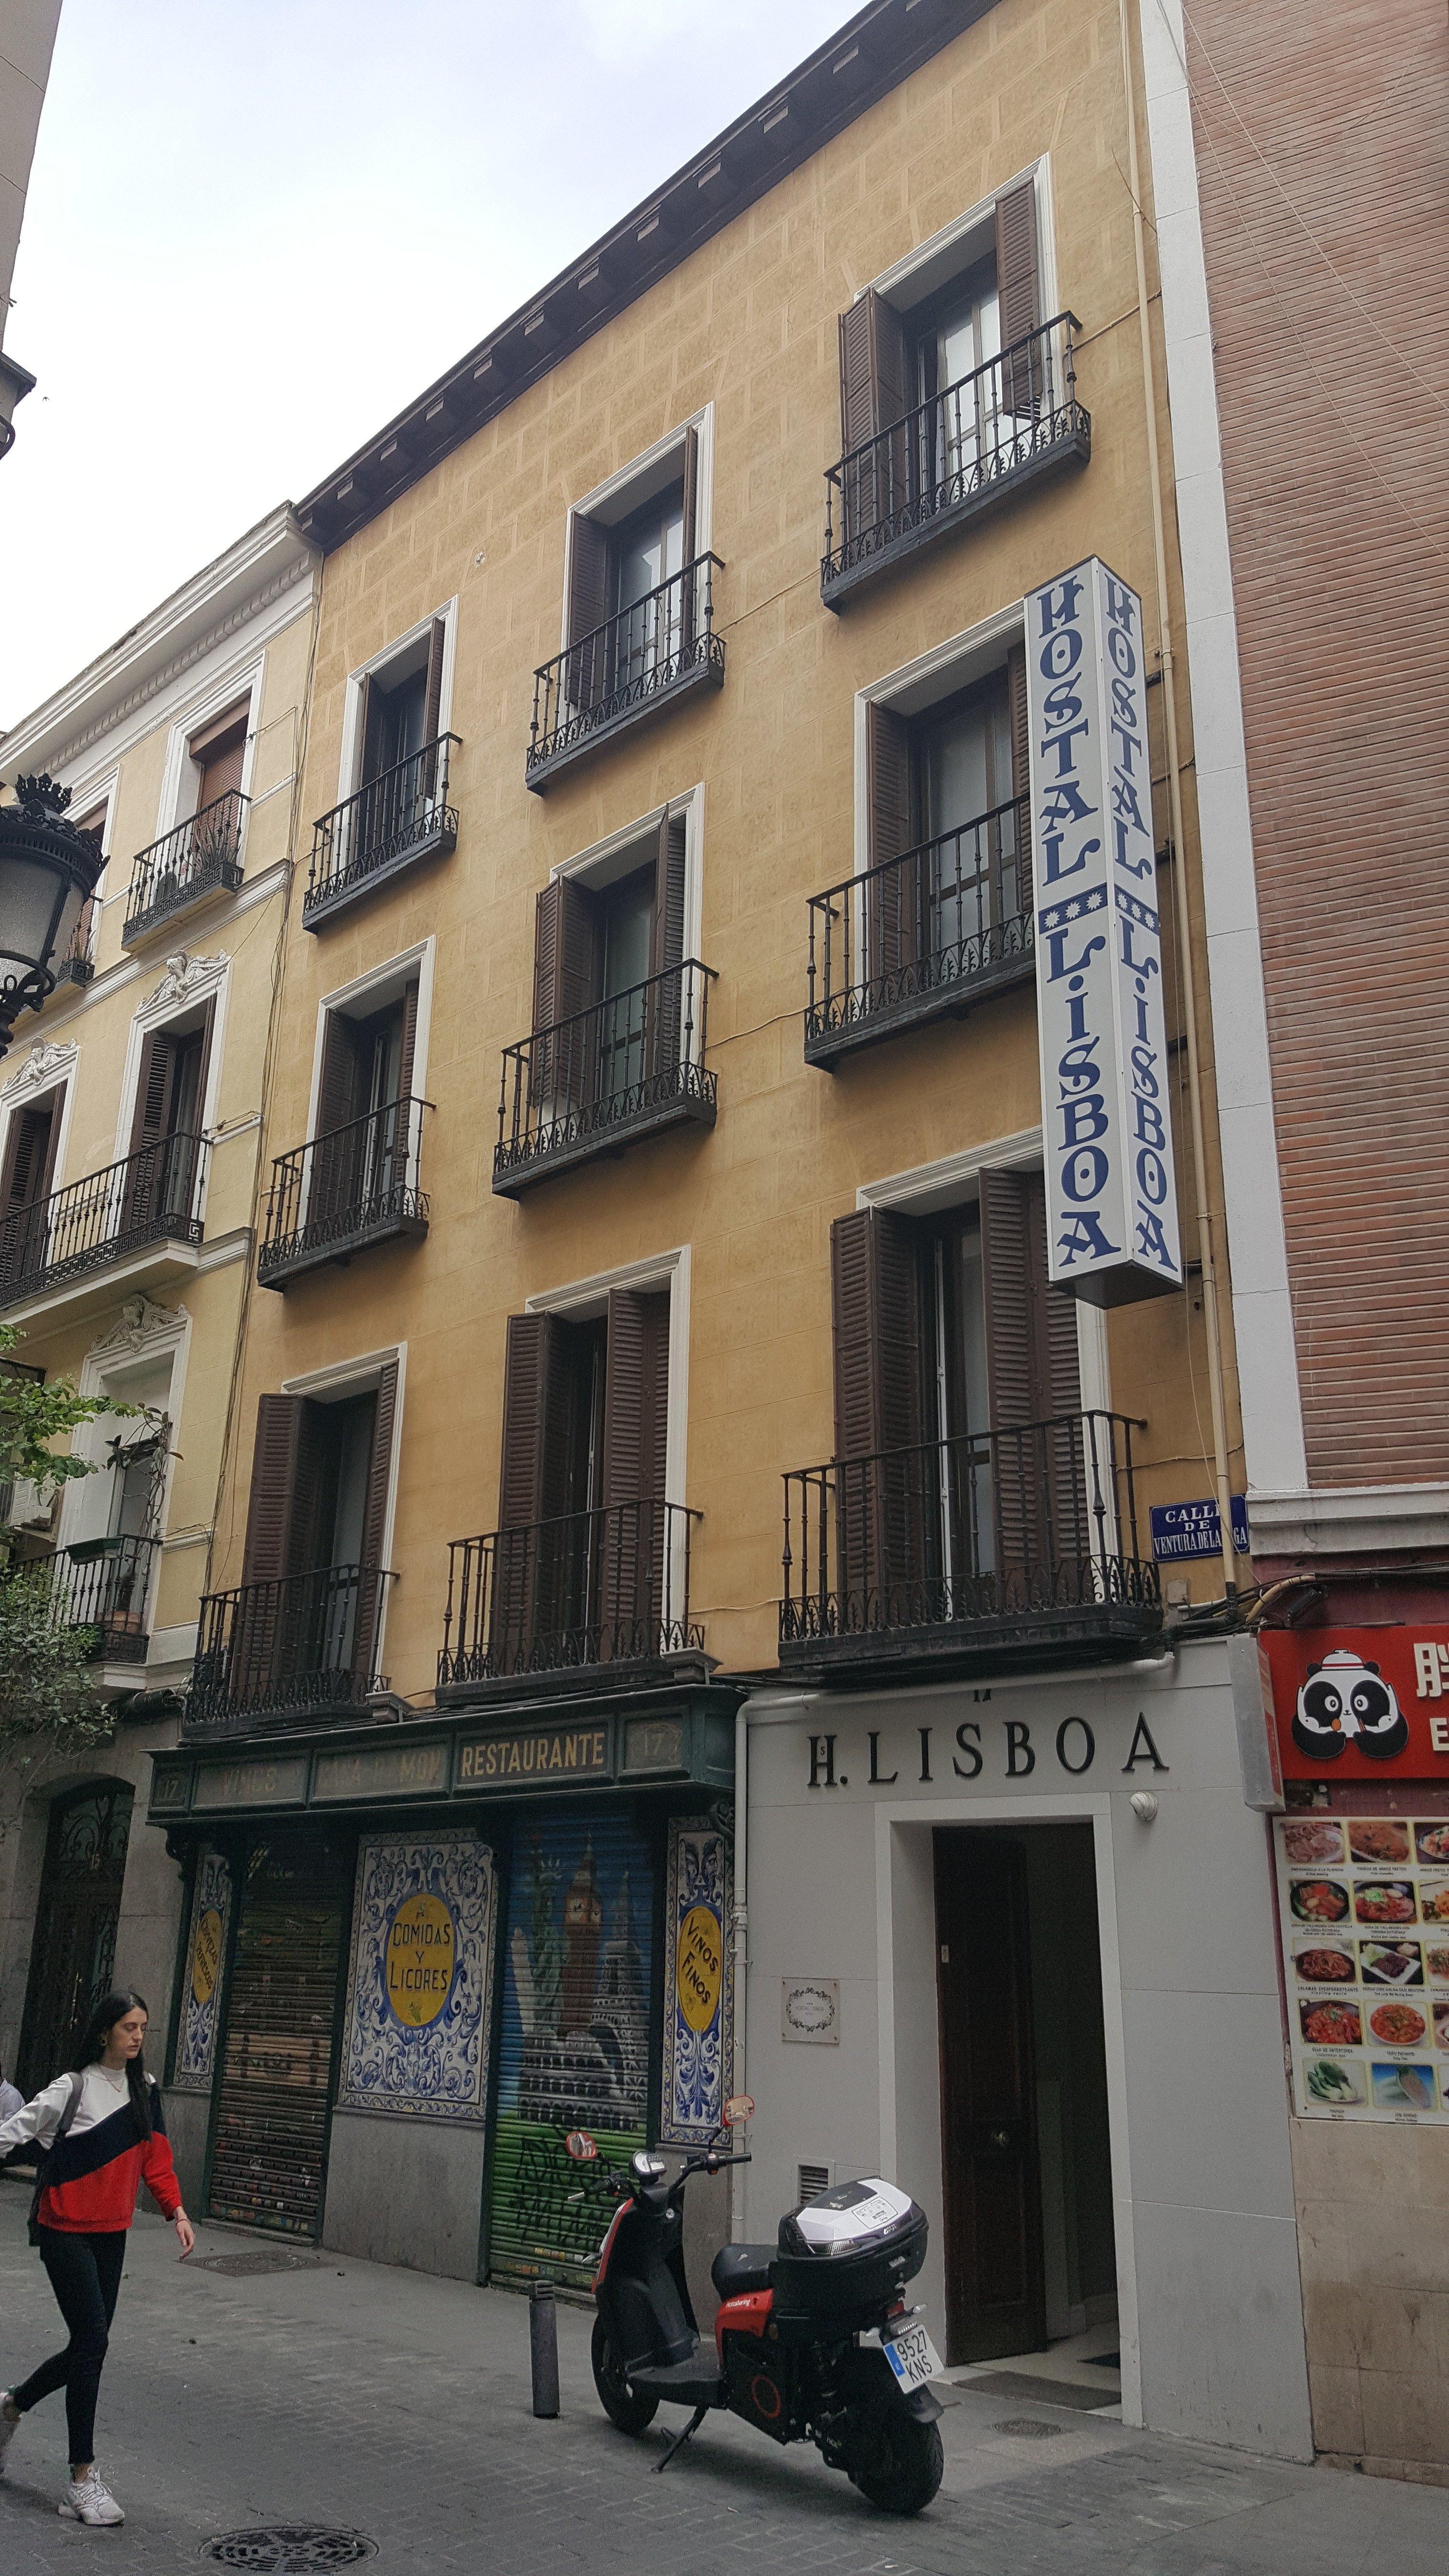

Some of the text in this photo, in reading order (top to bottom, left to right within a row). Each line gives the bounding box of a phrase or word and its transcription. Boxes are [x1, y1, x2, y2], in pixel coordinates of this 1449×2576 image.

[1038, 575, 1101, 886] HOSTAL
[1105, 573, 1153, 879] HOSTAL
[1153, 1533, 1197, 1555] VENTURA
[1197, 1531, 1209, 1548] DE
[1208, 1529, 1223, 1547] LA
[1185, 1520, 1210, 1531] DE
[461, 1732, 605, 1777] RESTAURANTE
[867, 1711, 1170, 1784] LISBOA
[393, 1922, 451, 1946] COMIDAS
[687, 1916, 719, 1973] VINOS
[415, 1950, 425, 1964] Y
[390, 1961, 448, 1990] LICORES
[681, 1950, 710, 2004] FINOS
[897, 2329, 927, 2362] 9527
[905, 2355, 933, 2383] KNS
